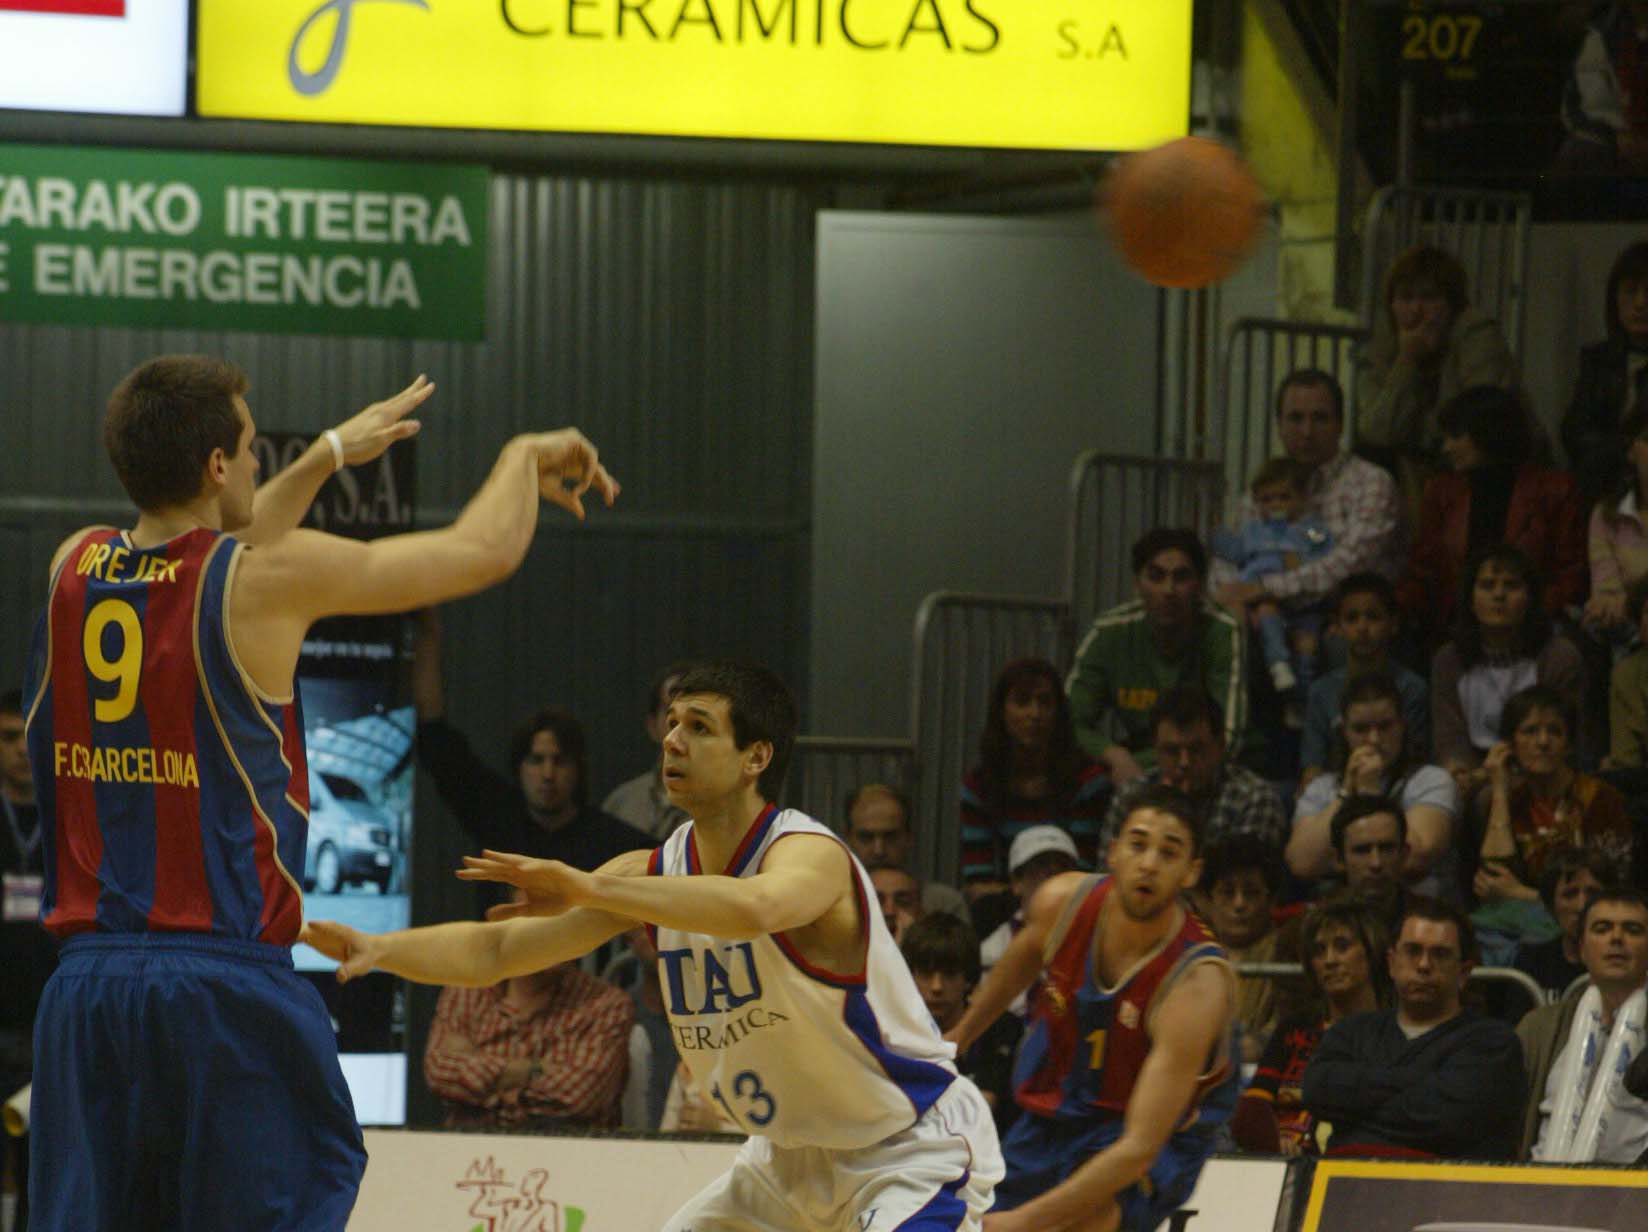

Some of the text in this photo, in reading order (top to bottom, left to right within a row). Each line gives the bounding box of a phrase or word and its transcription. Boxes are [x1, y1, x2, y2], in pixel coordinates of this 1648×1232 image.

[1403, 15, 1482, 59] 207
[0, 177, 471, 246] ARAKO IRTEERA
[33, 244, 421, 309] EMERGENCIA
[83, 599, 143, 722] 9
